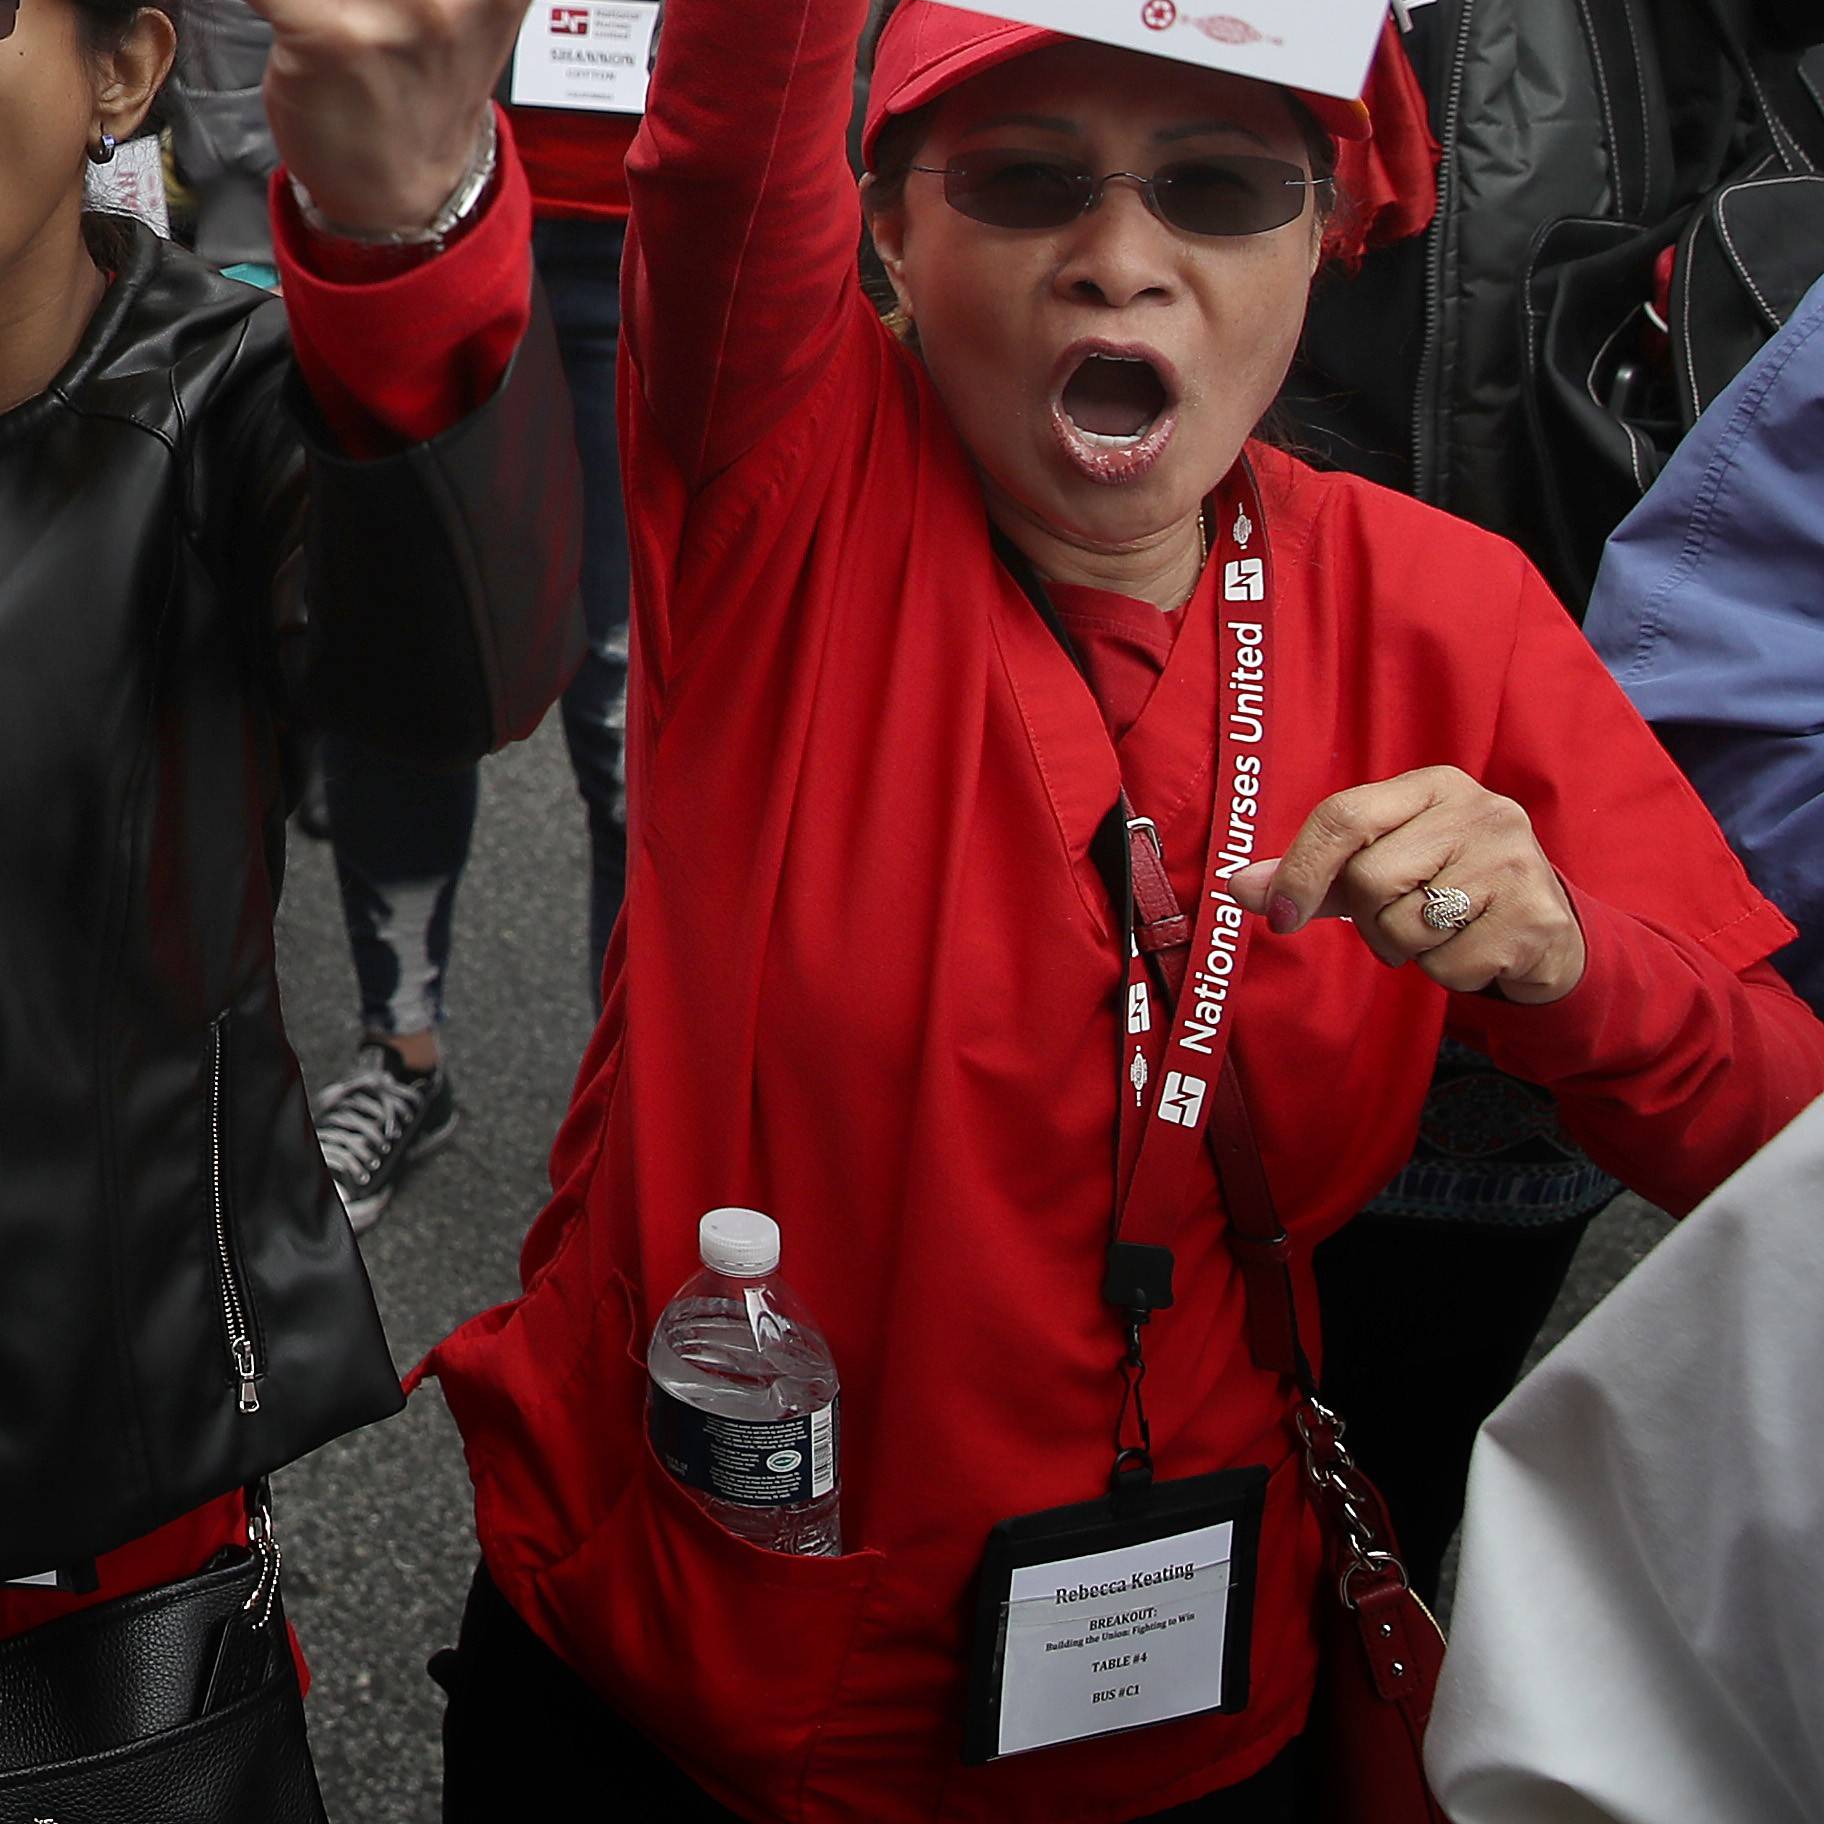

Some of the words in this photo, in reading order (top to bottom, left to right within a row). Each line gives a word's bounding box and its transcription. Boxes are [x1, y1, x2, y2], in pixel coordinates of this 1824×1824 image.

[1227, 619, 1265, 744] United
[1215, 755, 1263, 881] Nurses
[1178, 889, 1246, 1056] National
[1055, 1578, 1127, 1605] Rebecca
[1130, 1561, 1195, 1590] Keating
[1044, 1633, 1084, 1653] Building
[1085, 1633, 1101, 1645] the
[1101, 1627, 1131, 1643] Union:
[1132, 1619, 1167, 1638] Fighting
[1168, 1615, 1178, 1626] to
[1179, 1611, 1196, 1625] Win
[1088, 1606, 1159, 1632] BREAKOUT:
[1091, 1653, 1131, 1673] TABLE
[1132, 1651, 1148, 1666] #4
[1092, 1687, 1116, 1704] BUS
[1118, 1683, 1140, 1699] #C1
